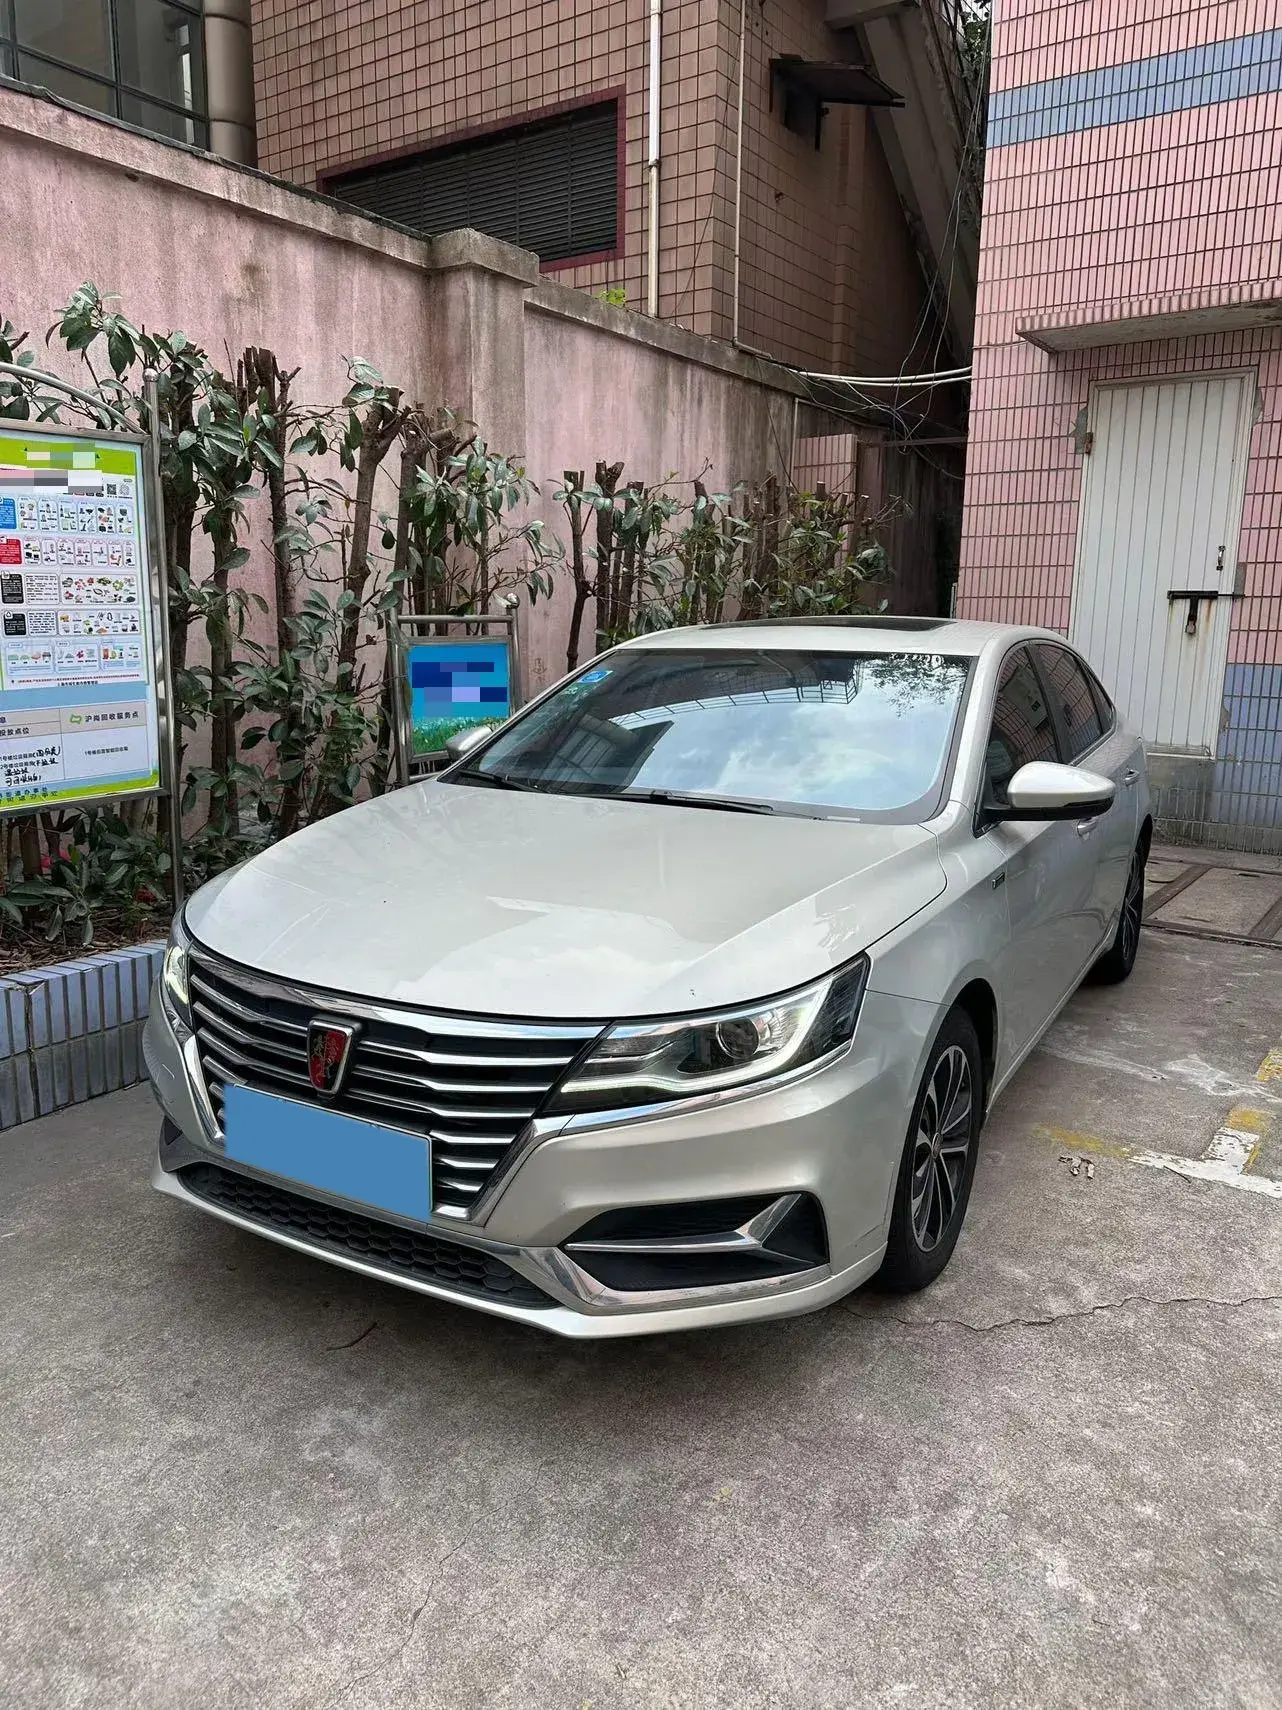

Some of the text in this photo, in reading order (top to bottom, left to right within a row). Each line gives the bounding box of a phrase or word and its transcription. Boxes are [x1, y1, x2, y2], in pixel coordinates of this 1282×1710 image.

[85, 711, 139, 722] 沪尚回收服务点
